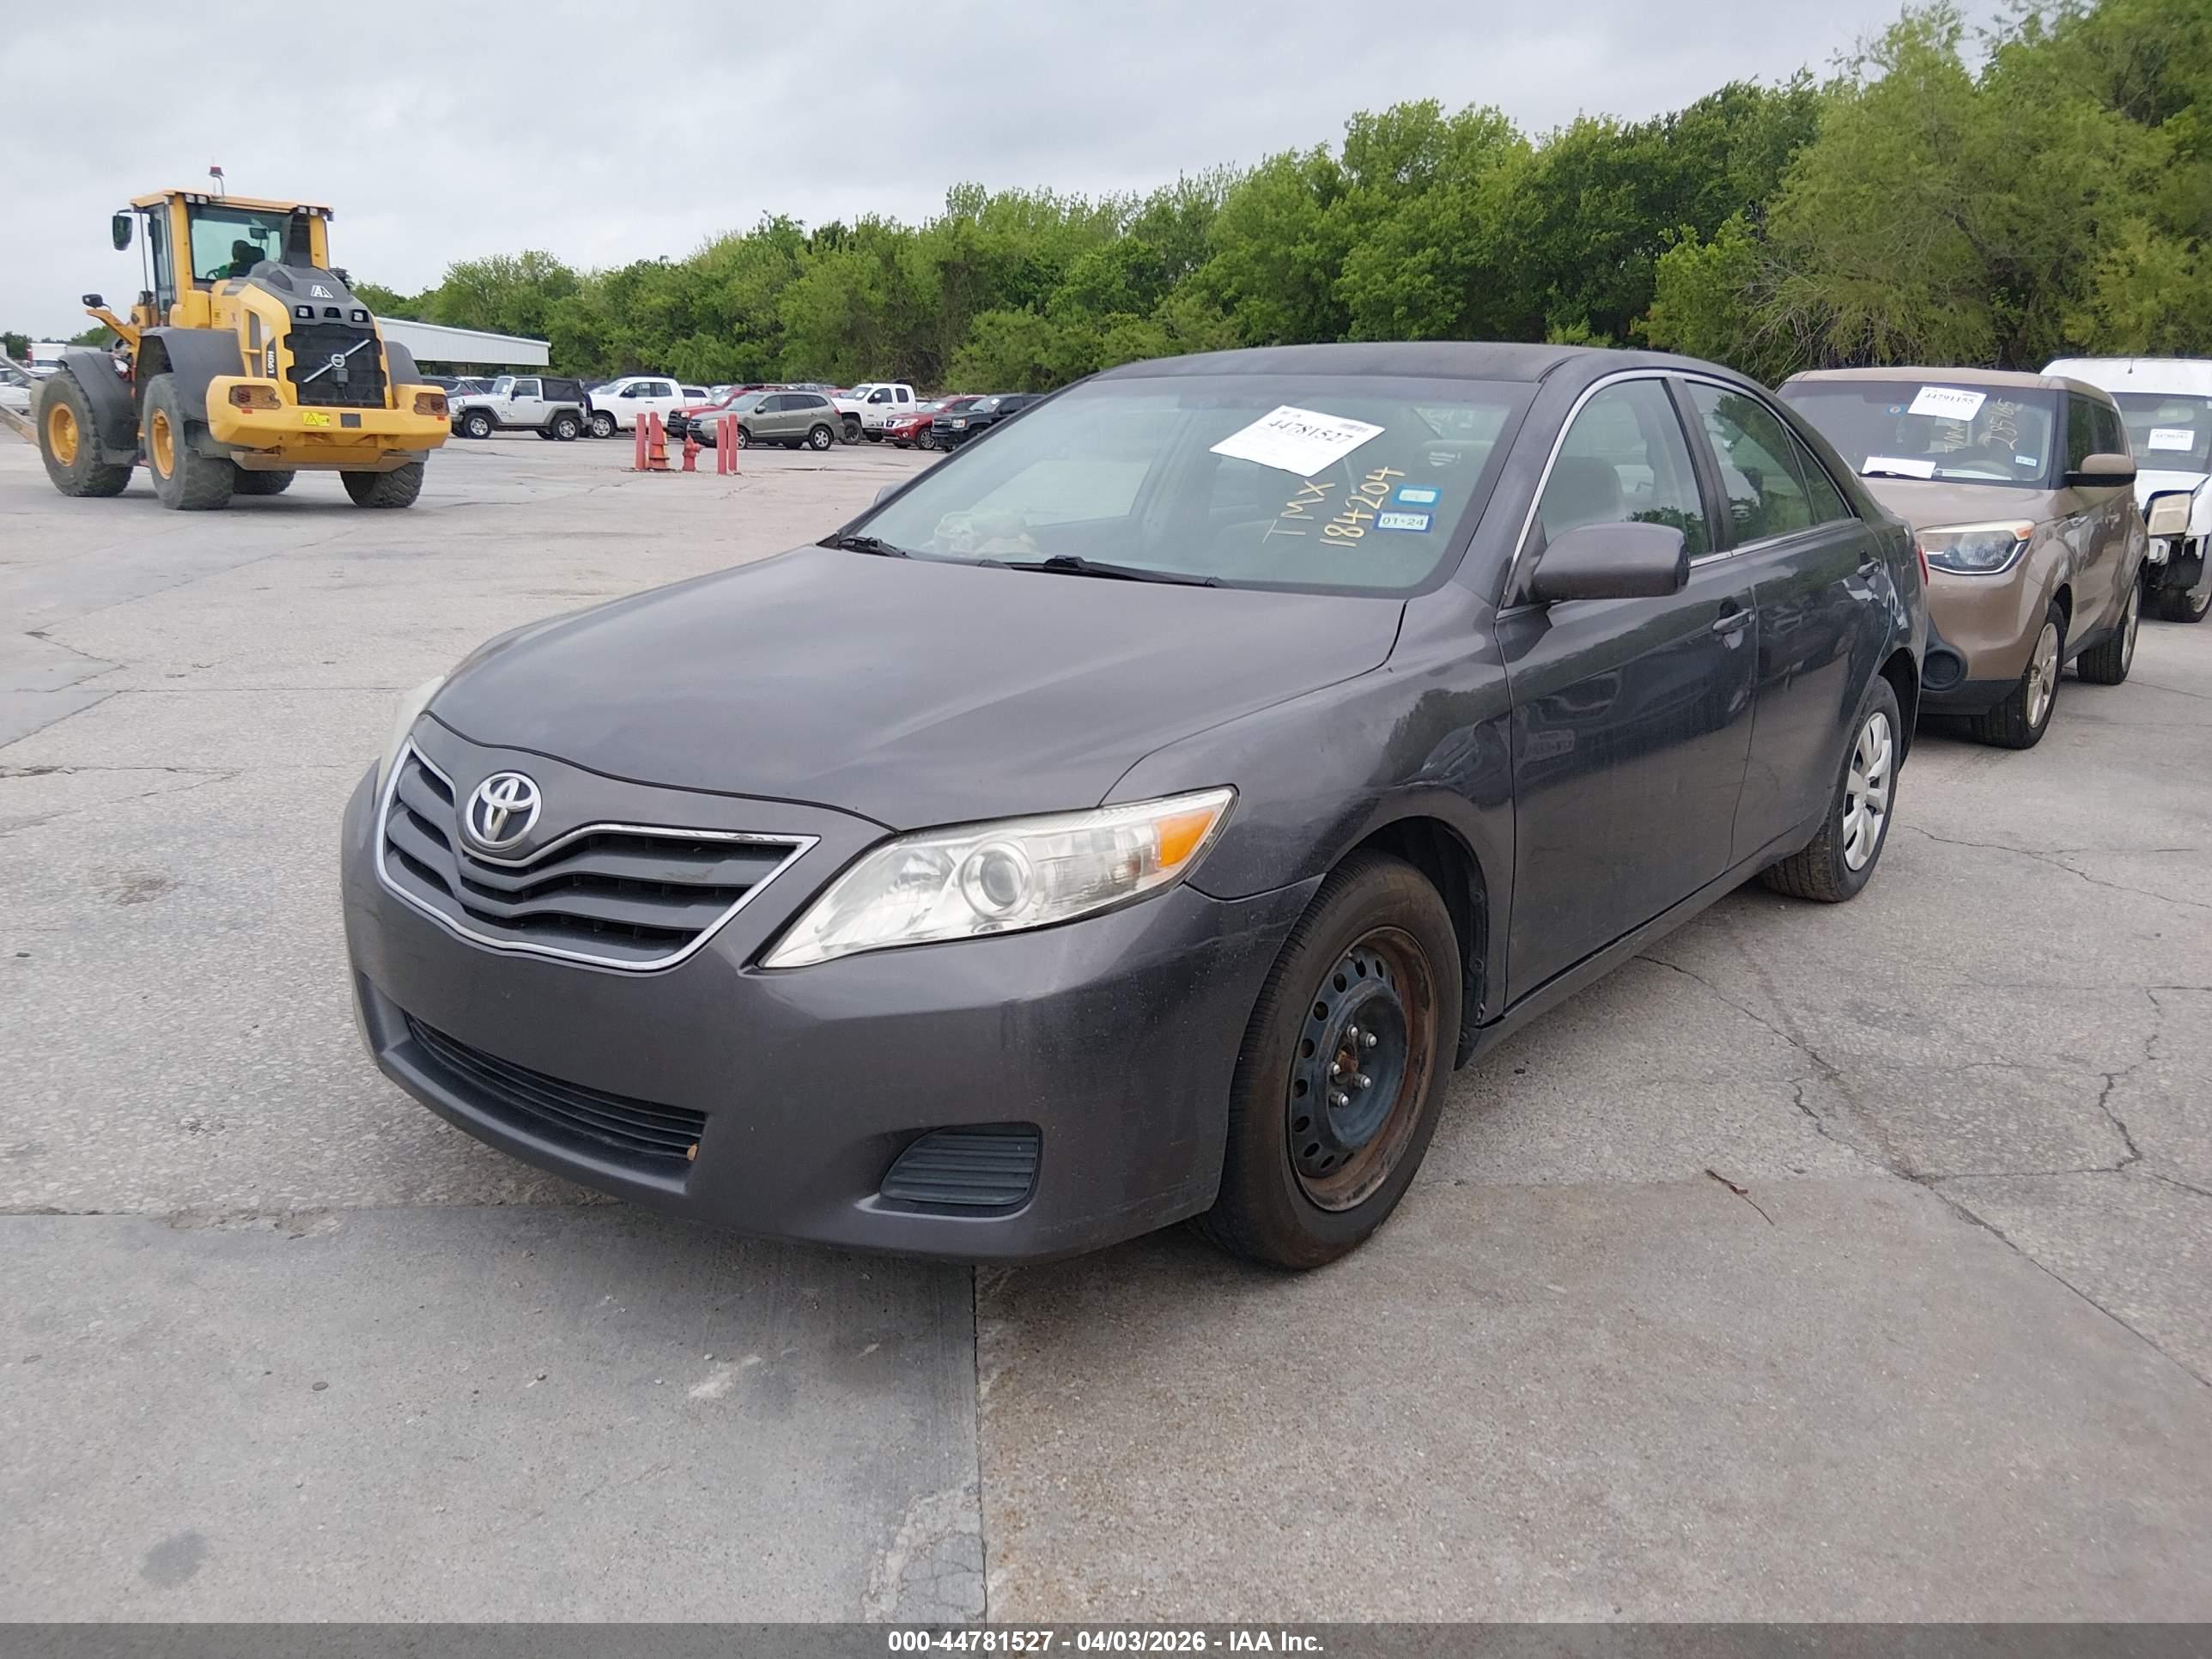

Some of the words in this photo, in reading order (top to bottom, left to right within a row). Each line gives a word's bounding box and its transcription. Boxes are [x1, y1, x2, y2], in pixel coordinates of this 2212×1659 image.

[1268, 419, 1354, 444] 44781527
[1262, 479, 1336, 544] TMX
[1320, 466, 1406, 547] 184204
